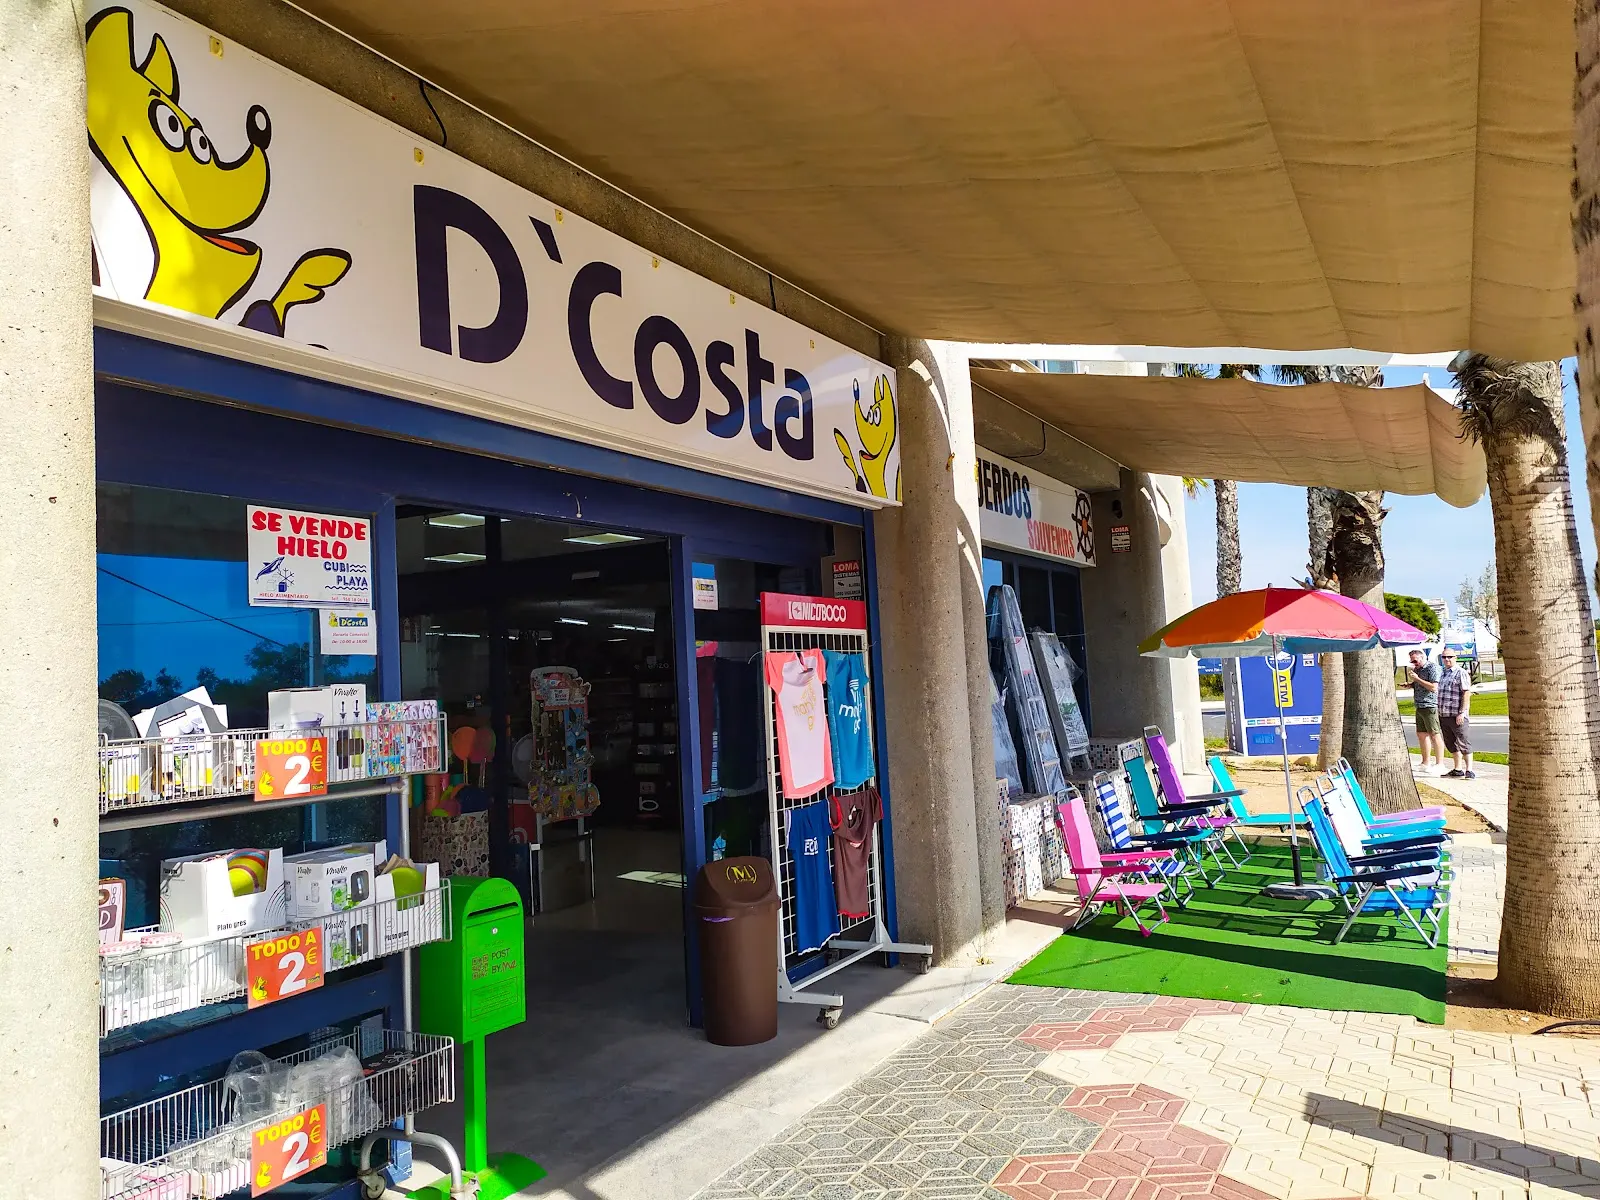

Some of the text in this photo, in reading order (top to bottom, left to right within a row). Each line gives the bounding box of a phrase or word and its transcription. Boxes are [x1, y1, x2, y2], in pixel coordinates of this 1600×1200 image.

[252, 510, 367, 540] SE VENDE
[277, 536, 347, 560] HIELO
[1027, 520, 1075, 558] SOUVENIRS
[324, 561, 350, 573] CUBI
[833, 562, 859, 572] LOMA
[337, 575, 368, 587] PLAYA
[802, 602, 847, 622] NICOBOCO
[1279, 675, 1289, 702] ATM
[259, 739, 323, 757] TODO A
[250, 930, 316, 961] TODO A
[491, 947, 511, 961] POST
[255, 1108, 321, 1147] TODO A
